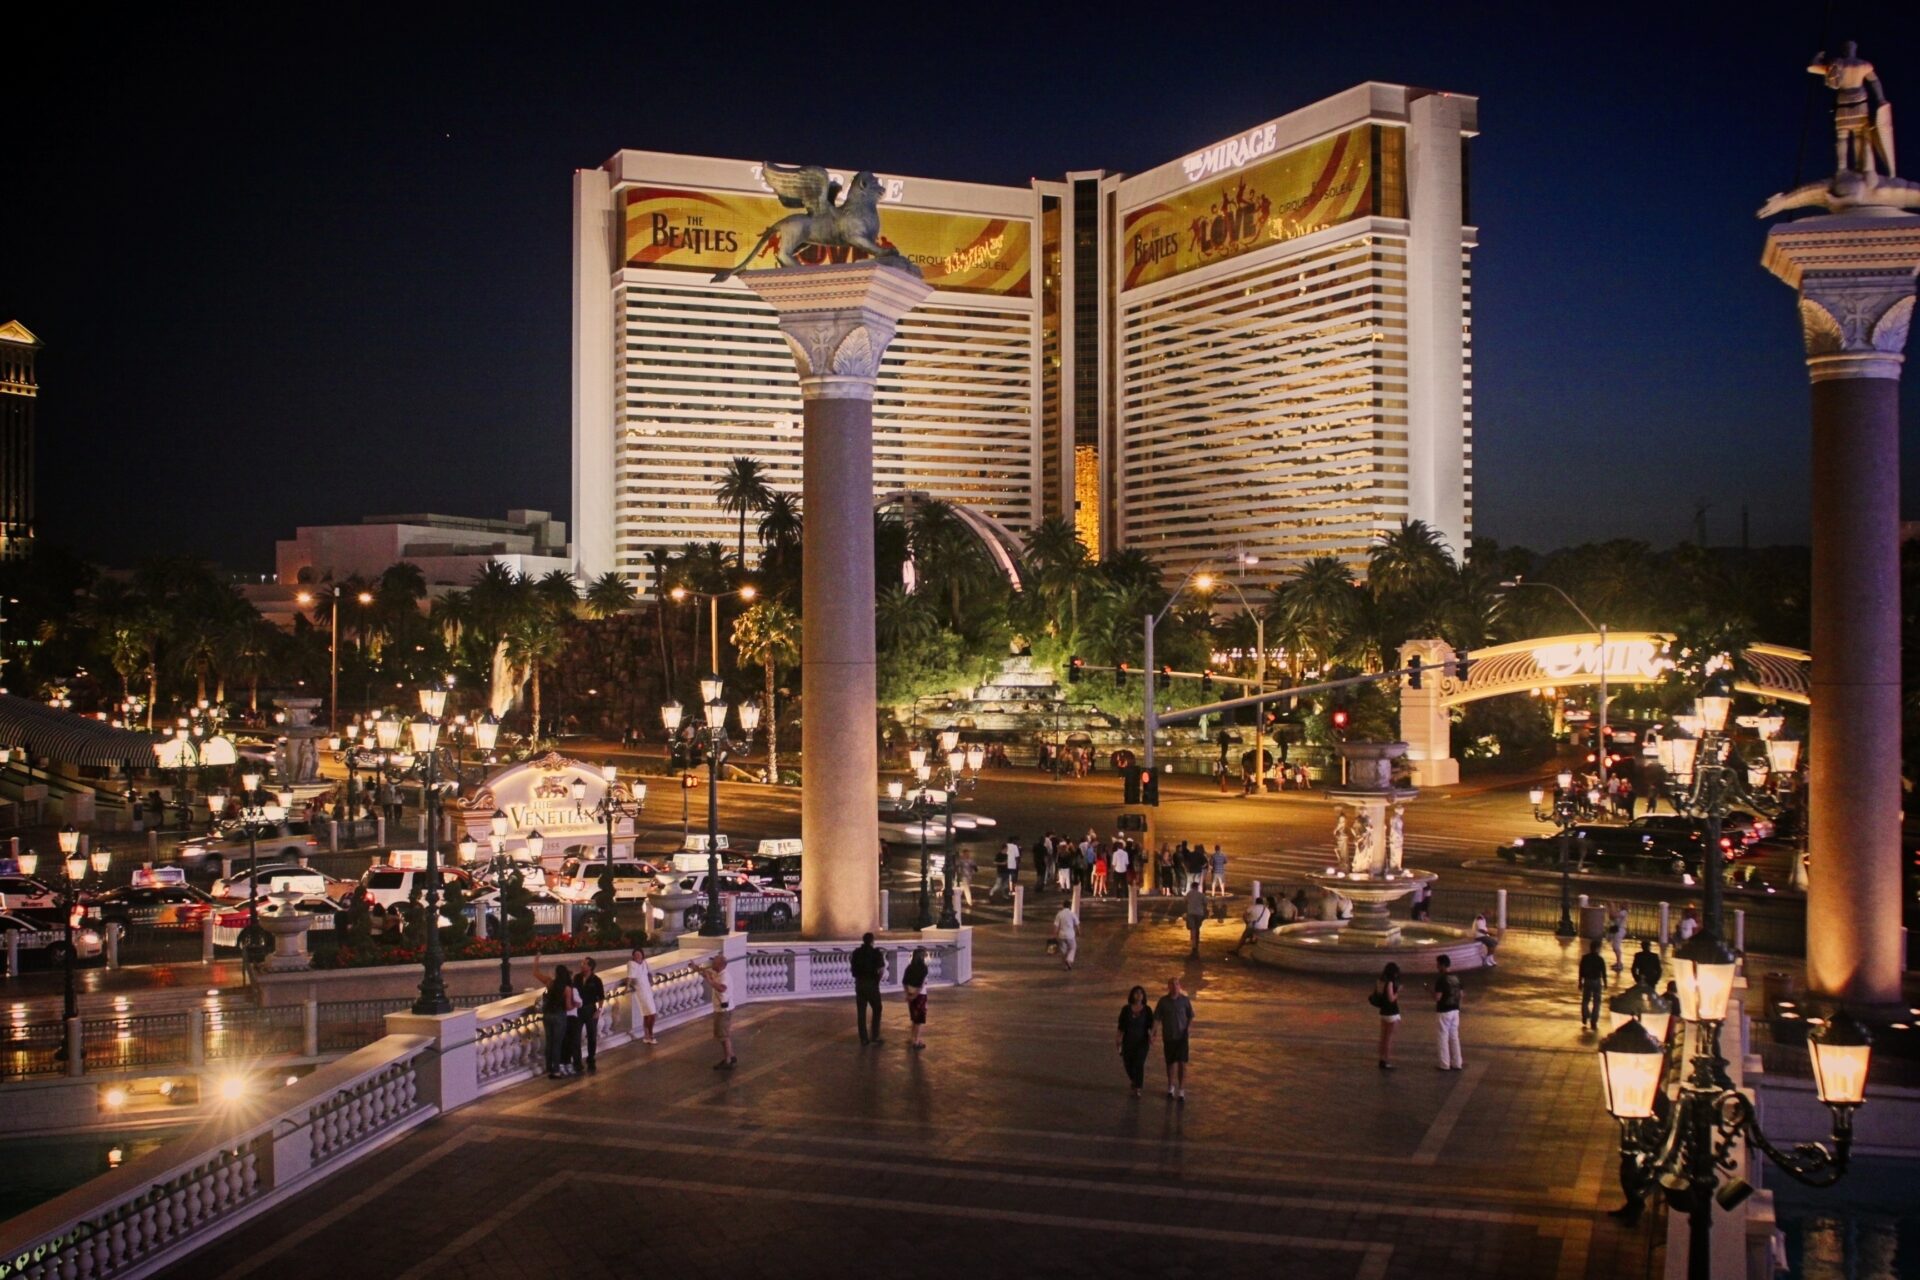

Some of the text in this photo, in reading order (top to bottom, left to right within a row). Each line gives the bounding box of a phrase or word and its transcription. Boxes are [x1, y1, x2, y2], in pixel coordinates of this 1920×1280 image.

[1189, 124, 1278, 182] MIRAGE
[652, 213, 738, 254] BEATLES
[687, 216, 704, 227] THE
[1200, 203, 1258, 252] LOVE
[1134, 233, 1178, 264] BEATLES
[511, 806, 597, 830] VENETIAN
[533, 801, 552, 810] THE
